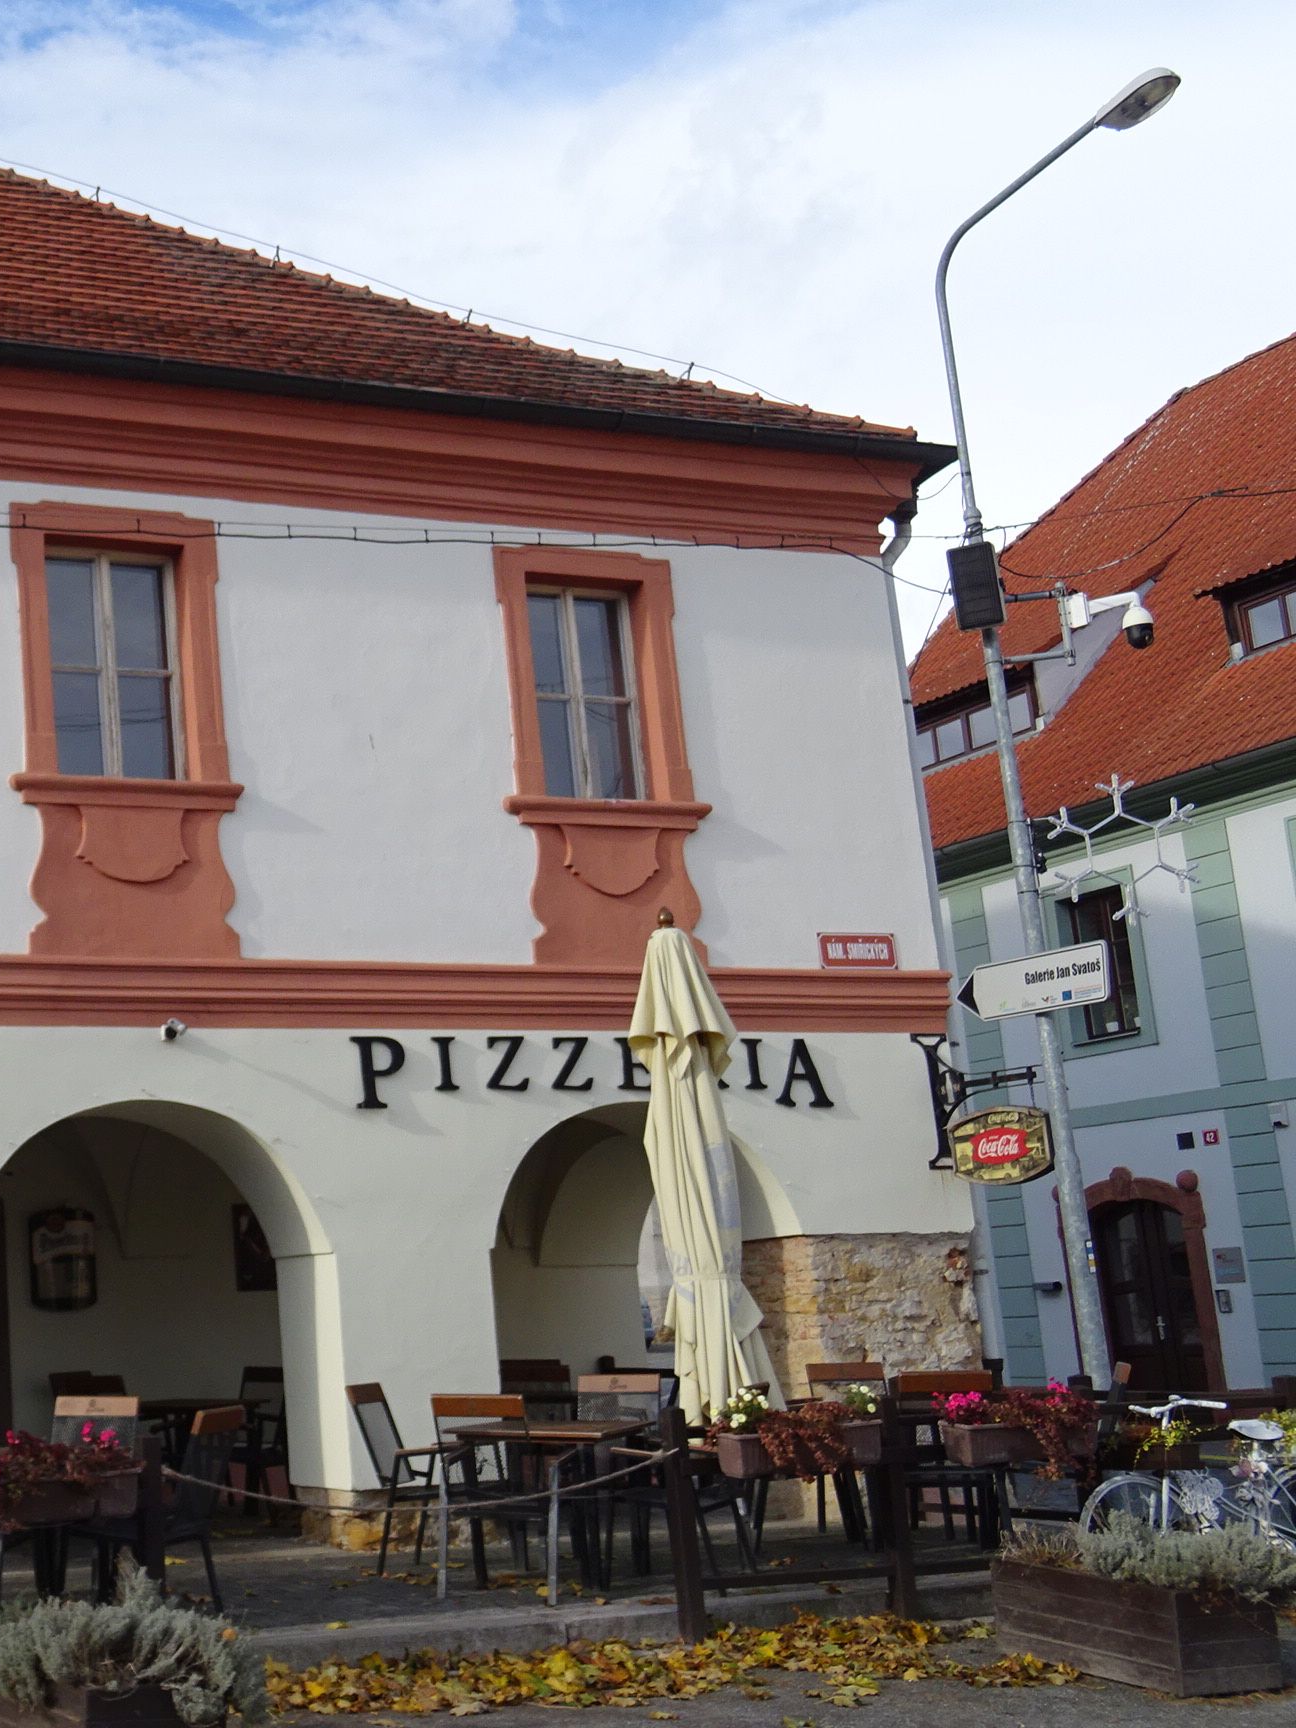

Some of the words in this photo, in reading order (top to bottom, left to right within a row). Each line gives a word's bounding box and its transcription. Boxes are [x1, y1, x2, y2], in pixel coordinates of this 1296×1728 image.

[826, 938, 846, 960] NÁM.
[1024, 968, 1055, 985] Galerie
[1056, 966, 1071, 980] Jan
[1071, 957, 1101, 976] Svatoš
[349, 1035, 834, 1108] PIZZEIA
[1206, 1132, 1215, 1143] 42
